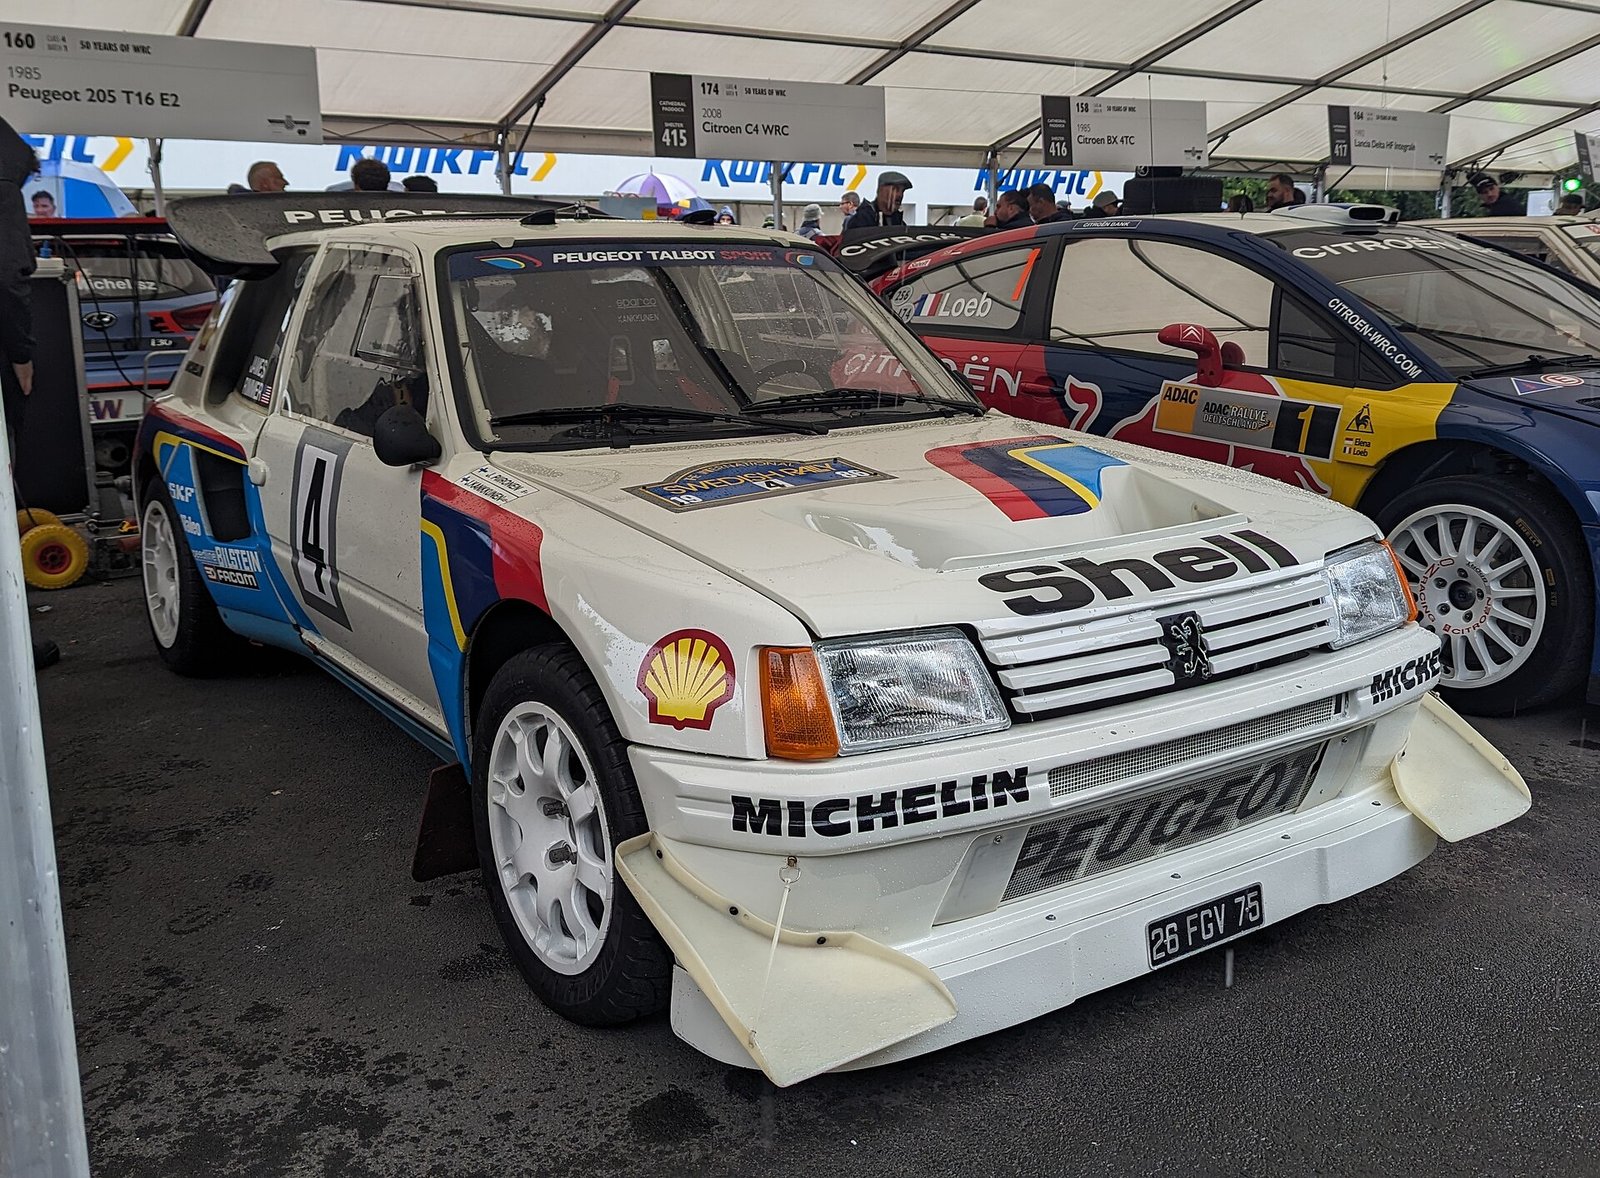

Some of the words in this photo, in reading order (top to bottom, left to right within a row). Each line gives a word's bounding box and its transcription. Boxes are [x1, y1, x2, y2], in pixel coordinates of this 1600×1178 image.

[4, 32, 35, 49] 160
[80, 40, 91, 50] 50
[93, 41, 118, 52] YEARS
[120, 43, 130, 53] OF
[132, 44, 152, 54] WRC
[7, 66, 42, 80] 1985
[8, 83, 81, 104] Peugeot
[86, 88, 117, 103] 205
[121, 90, 156, 106] T16
[160, 93, 181, 108] E2
[701, 82, 719, 96] 174
[744, 87, 752, 95] 50
[752, 87, 767, 96] YEARS
[775, 89, 787, 97] WRC
[702, 108, 722, 119] 2008
[1076, 102, 1090, 113] 158
[1354, 110, 1364, 121] 164
[702, 121, 742, 135] Citroen
[744, 122, 760, 135] C4
[761, 123, 790, 137] WRC
[1077, 123, 1091, 133] 1985
[661, 128, 688, 147] 415
[1077, 135, 1105, 145] Citroen
[1106, 135, 1119, 145] BX
[1119, 135, 1136, 146] 4TC
[1353, 139, 1371, 148] Lancia
[1371, 140, 1386, 150] Delta
[1048, 141, 1068, 157] 416
[1333, 143, 1348, 158] 417
[553, 251, 642, 263] PEUGEOT
[646, 250, 716, 261] TALBOT
[719, 250, 776, 261] SPORT
[937, 291, 993, 318] Loeb
[1327, 297, 1423, 379] CITROEN-WRC.COM
[1162, 386, 1198, 405] ADAC
[1202, 402, 1231, 416] ADAC
[1230, 405, 1268, 423] RALLYE
[1203, 413, 1259, 431] DEUTSCHLAND
[1297, 404, 1316, 453] 1
[1354, 437, 1371, 448] Elena
[1353, 447, 1369, 457] Loeb
[662, 471, 783, 496] SWEDISH
[782, 461, 837, 477] RALLY
[763, 480, 786, 491] 4
[168, 482, 196, 503] SKF
[669, 494, 704, 506] 19
[302, 457, 328, 596] 4
[214, 546, 262, 572] BILSTEIN
[215, 568, 258, 587] FACOM
[977, 529, 1300, 616] Shell
[731, 766, 1029, 838] MICHELIN
[1151, 921, 1181, 962] 26
[1185, 902, 1226, 946] FGV
[1234, 890, 1262, 927] 75
